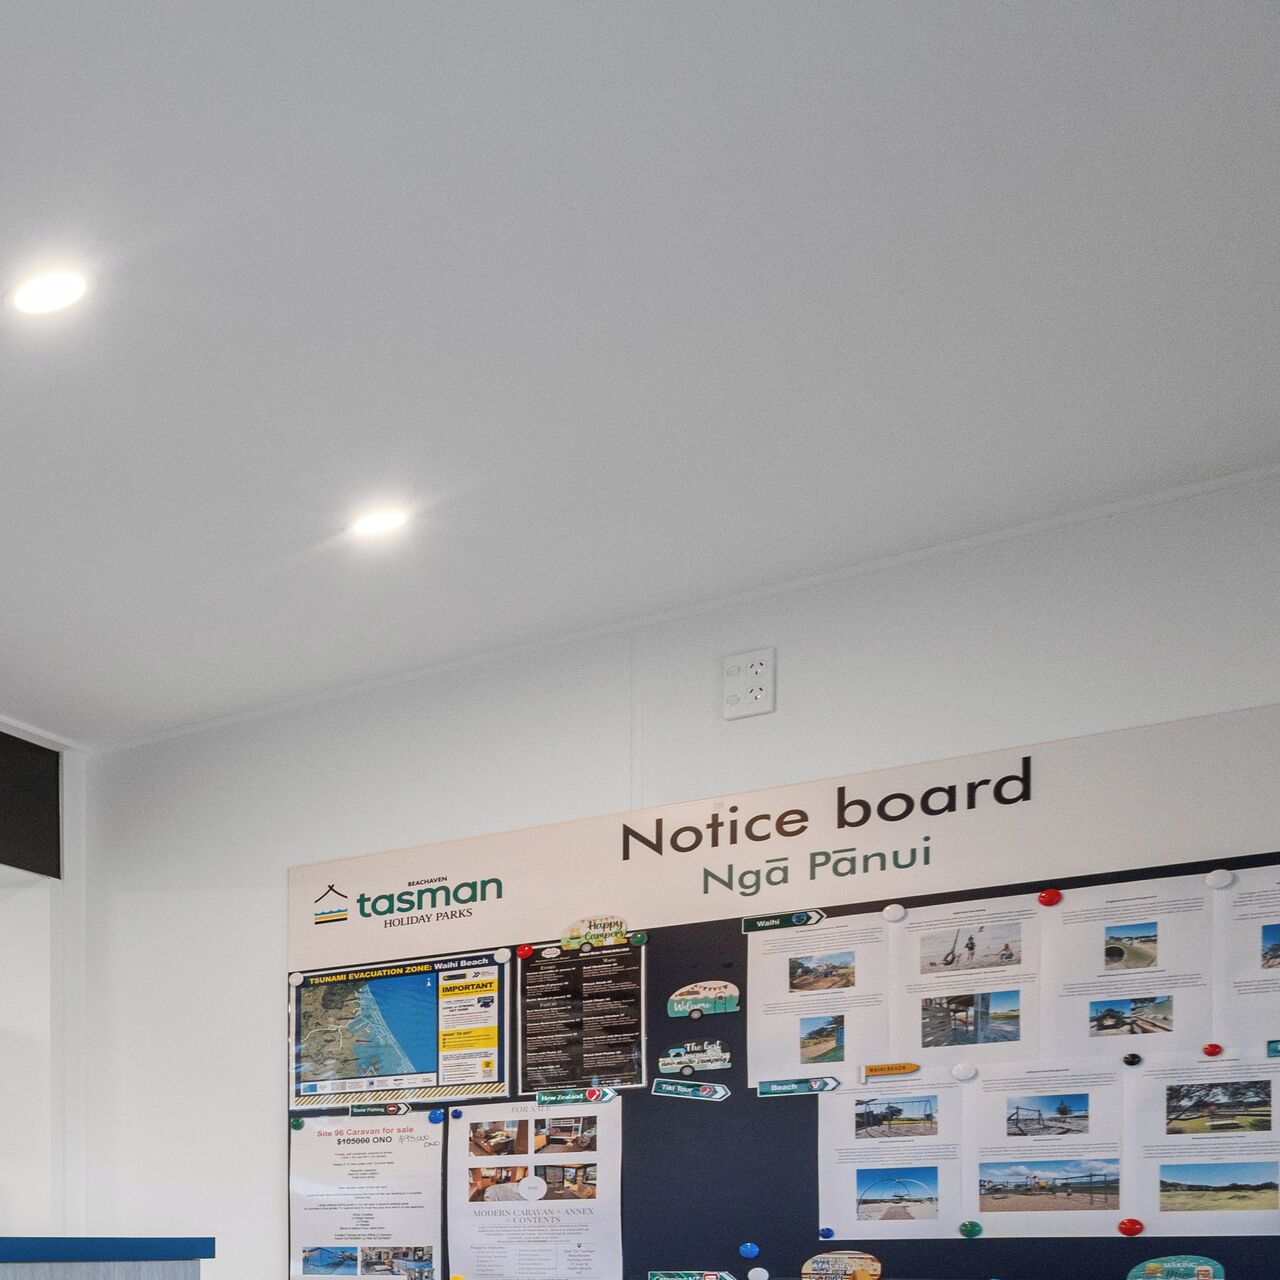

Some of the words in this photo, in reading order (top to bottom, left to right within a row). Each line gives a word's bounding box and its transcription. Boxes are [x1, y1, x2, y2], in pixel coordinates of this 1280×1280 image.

[622, 806, 809, 861] Notice
[837, 756, 1032, 829] board
[703, 857, 789, 897] Ngā
[809, 836, 931, 881] Pānui
[408, 876, 448, 887] BEACHAVEN
[356, 877, 503, 918] tasman
[383, 914, 432, 928] HOLIDAY
[436, 908, 473, 921] PARKS
[756, 919, 780, 927] Waihi
[587, 919, 623, 934] Happy
[309, 974, 347, 985] TSUNAMI
[348, 967, 403, 980] EVACUATION
[405, 965, 432, 974] ZONE:
[460, 958, 488, 968] Beach
[442, 981, 494, 993] IMPORTANT
[673, 1002, 712, 1012] Welcome
[662, 1083, 675, 1092] Tiki
[676, 1085, 694, 1093] Tour
[771, 1083, 798, 1091] Beach
[556, 1092, 584, 1100] Zealand
[346, 1128, 380, 1136] Caravan
[473, 1209, 511, 1217] MODERN
[513, 1208, 554, 1216] CARAVAN
[563, 1208, 594, 1216] ANNEX
[513, 1216, 561, 1224] CONTENTS
